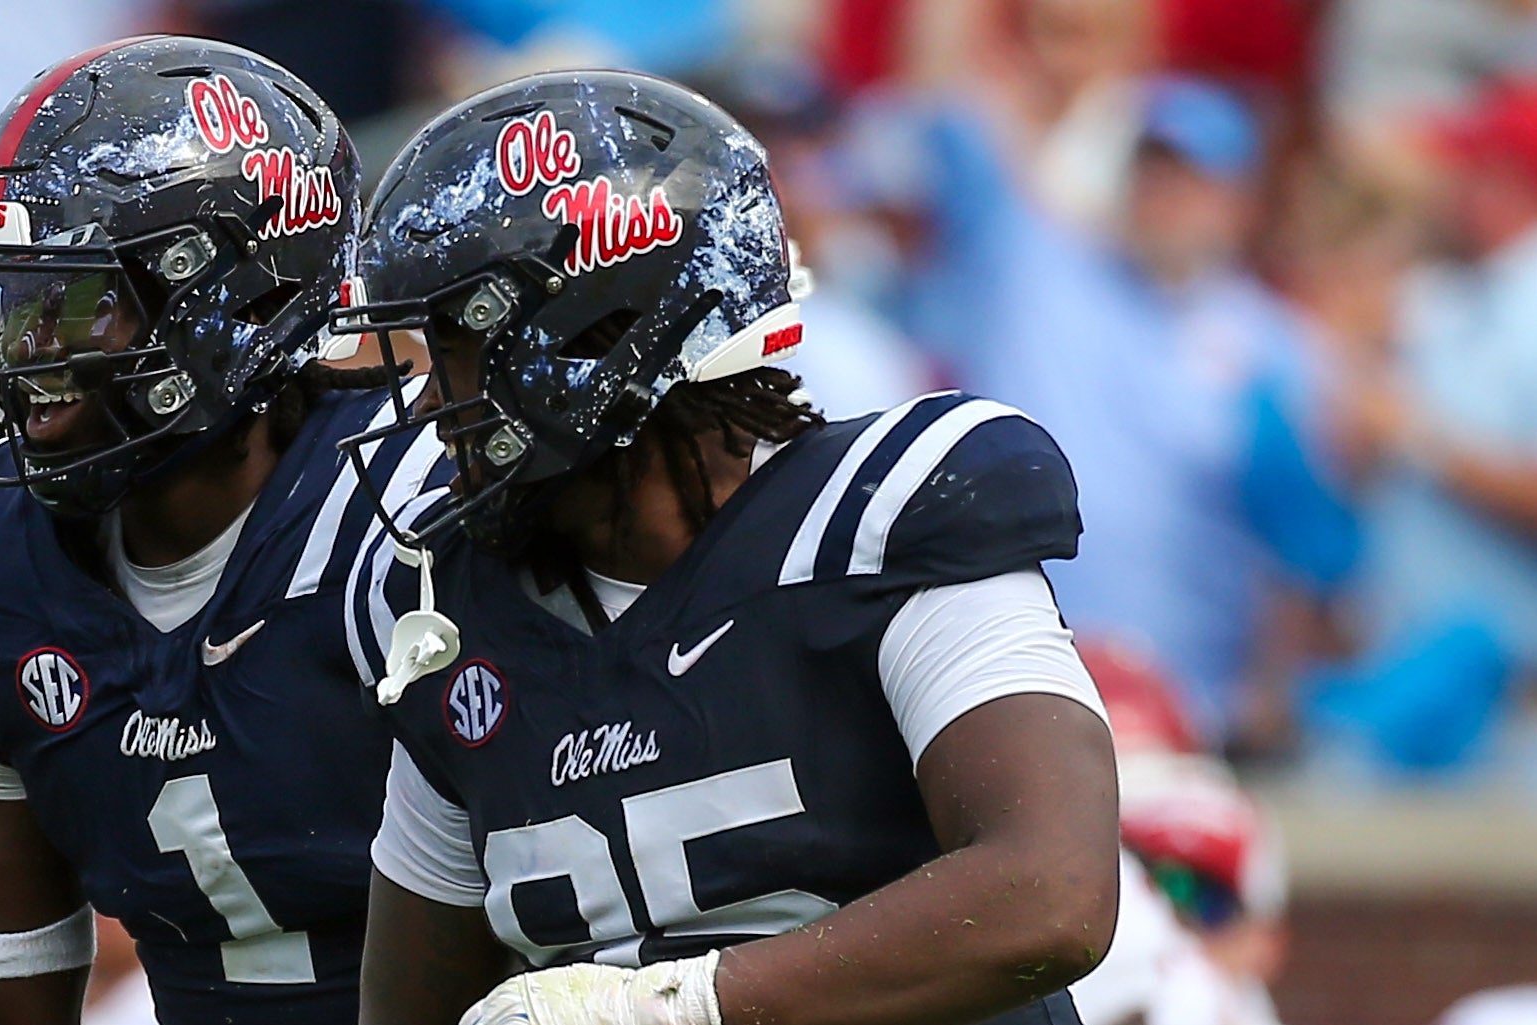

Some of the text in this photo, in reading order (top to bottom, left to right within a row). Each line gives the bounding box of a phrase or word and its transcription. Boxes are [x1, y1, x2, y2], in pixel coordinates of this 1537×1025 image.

[187, 75, 269, 154] Ole
[496, 110, 582, 197] Ole
[242, 146, 342, 240] Miss
[542, 175, 684, 277] Miss
[21, 653, 82, 725] SEC
[448, 665, 503, 741] SEC
[152, 717, 217, 761] Miss
[551, 720, 661, 787] Ole Miss
[148, 774, 316, 984] 1
